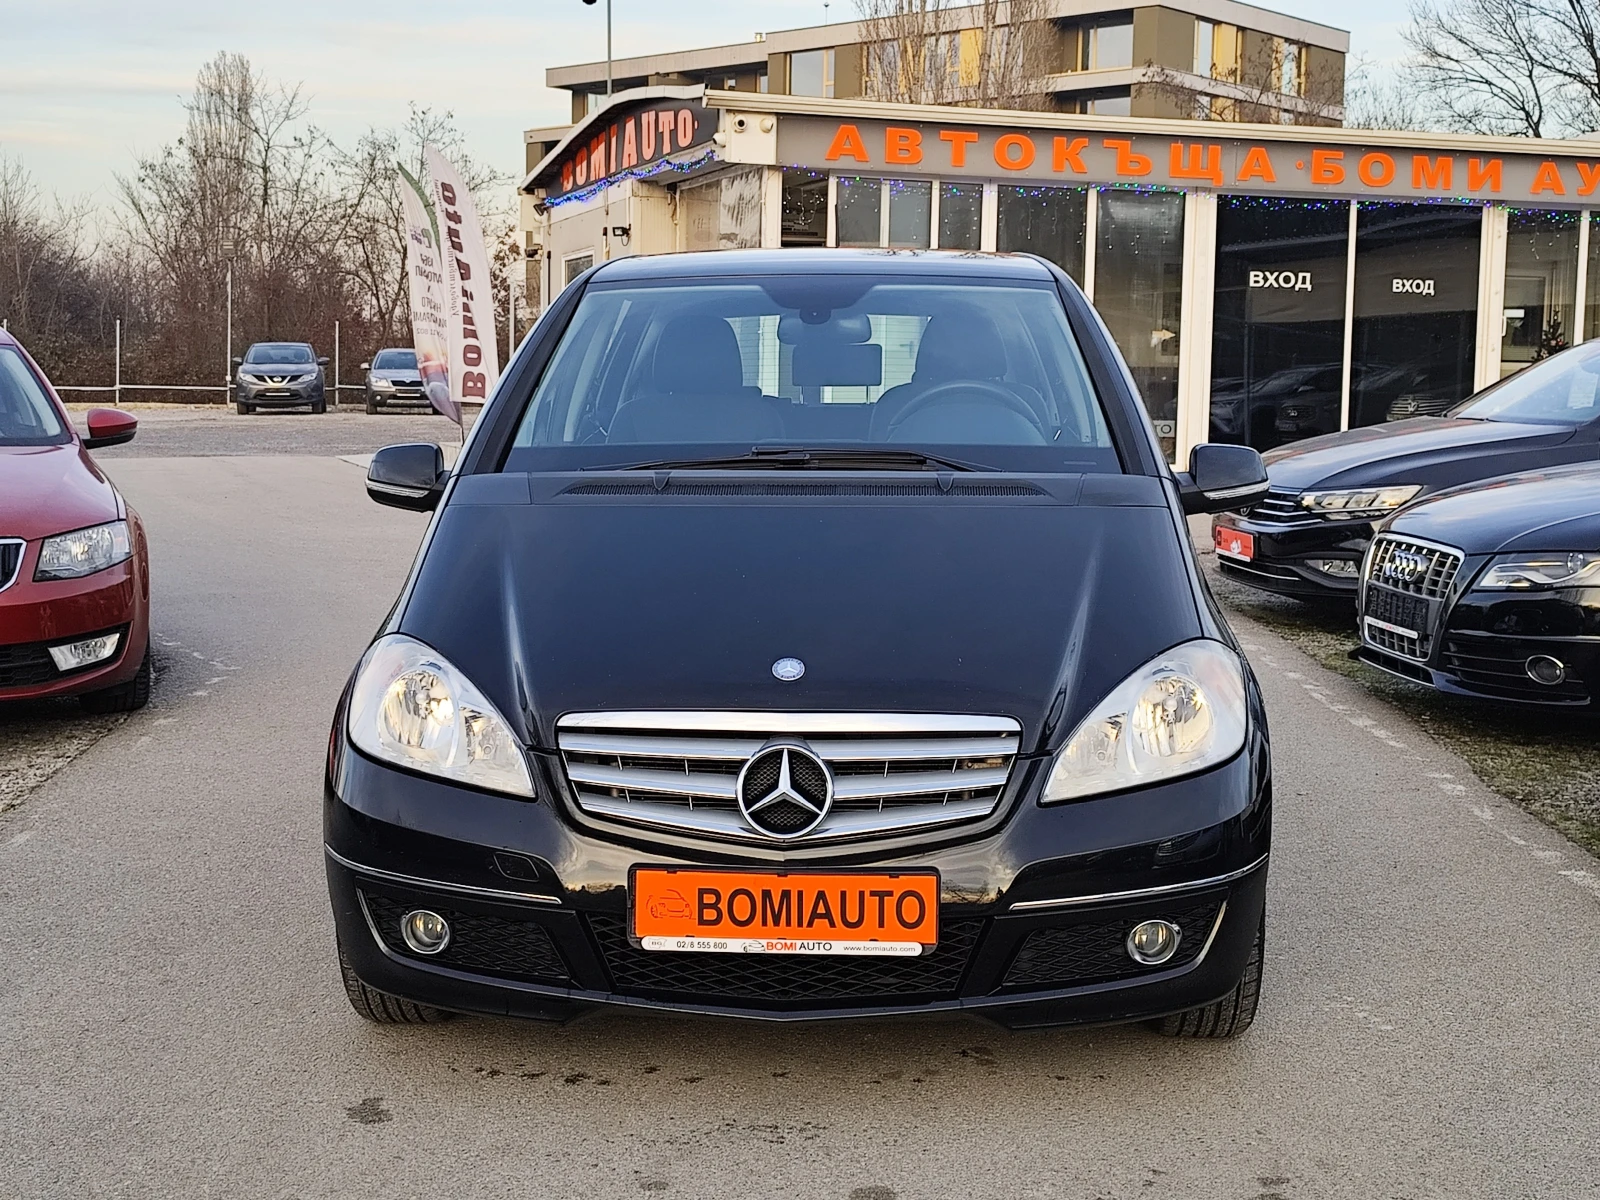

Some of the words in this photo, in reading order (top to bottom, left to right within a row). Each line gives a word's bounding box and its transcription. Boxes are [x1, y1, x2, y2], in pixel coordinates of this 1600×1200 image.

[562, 108, 693, 192] BOMIAUTO
[825, 124, 1277, 187] АВТОКЪЩА
[1248, 271, 1312, 292] ВХОД
[1391, 278, 1435, 297] ВХОД
[697, 887, 926, 929] BOMIAUTO
[676, 940, 695, 949] 02/8
[697, 941, 711, 949] 555
[713, 942, 728, 950] 800
[766, 942, 797, 951] BOMI
[798, 942, 833, 951] AUTO
